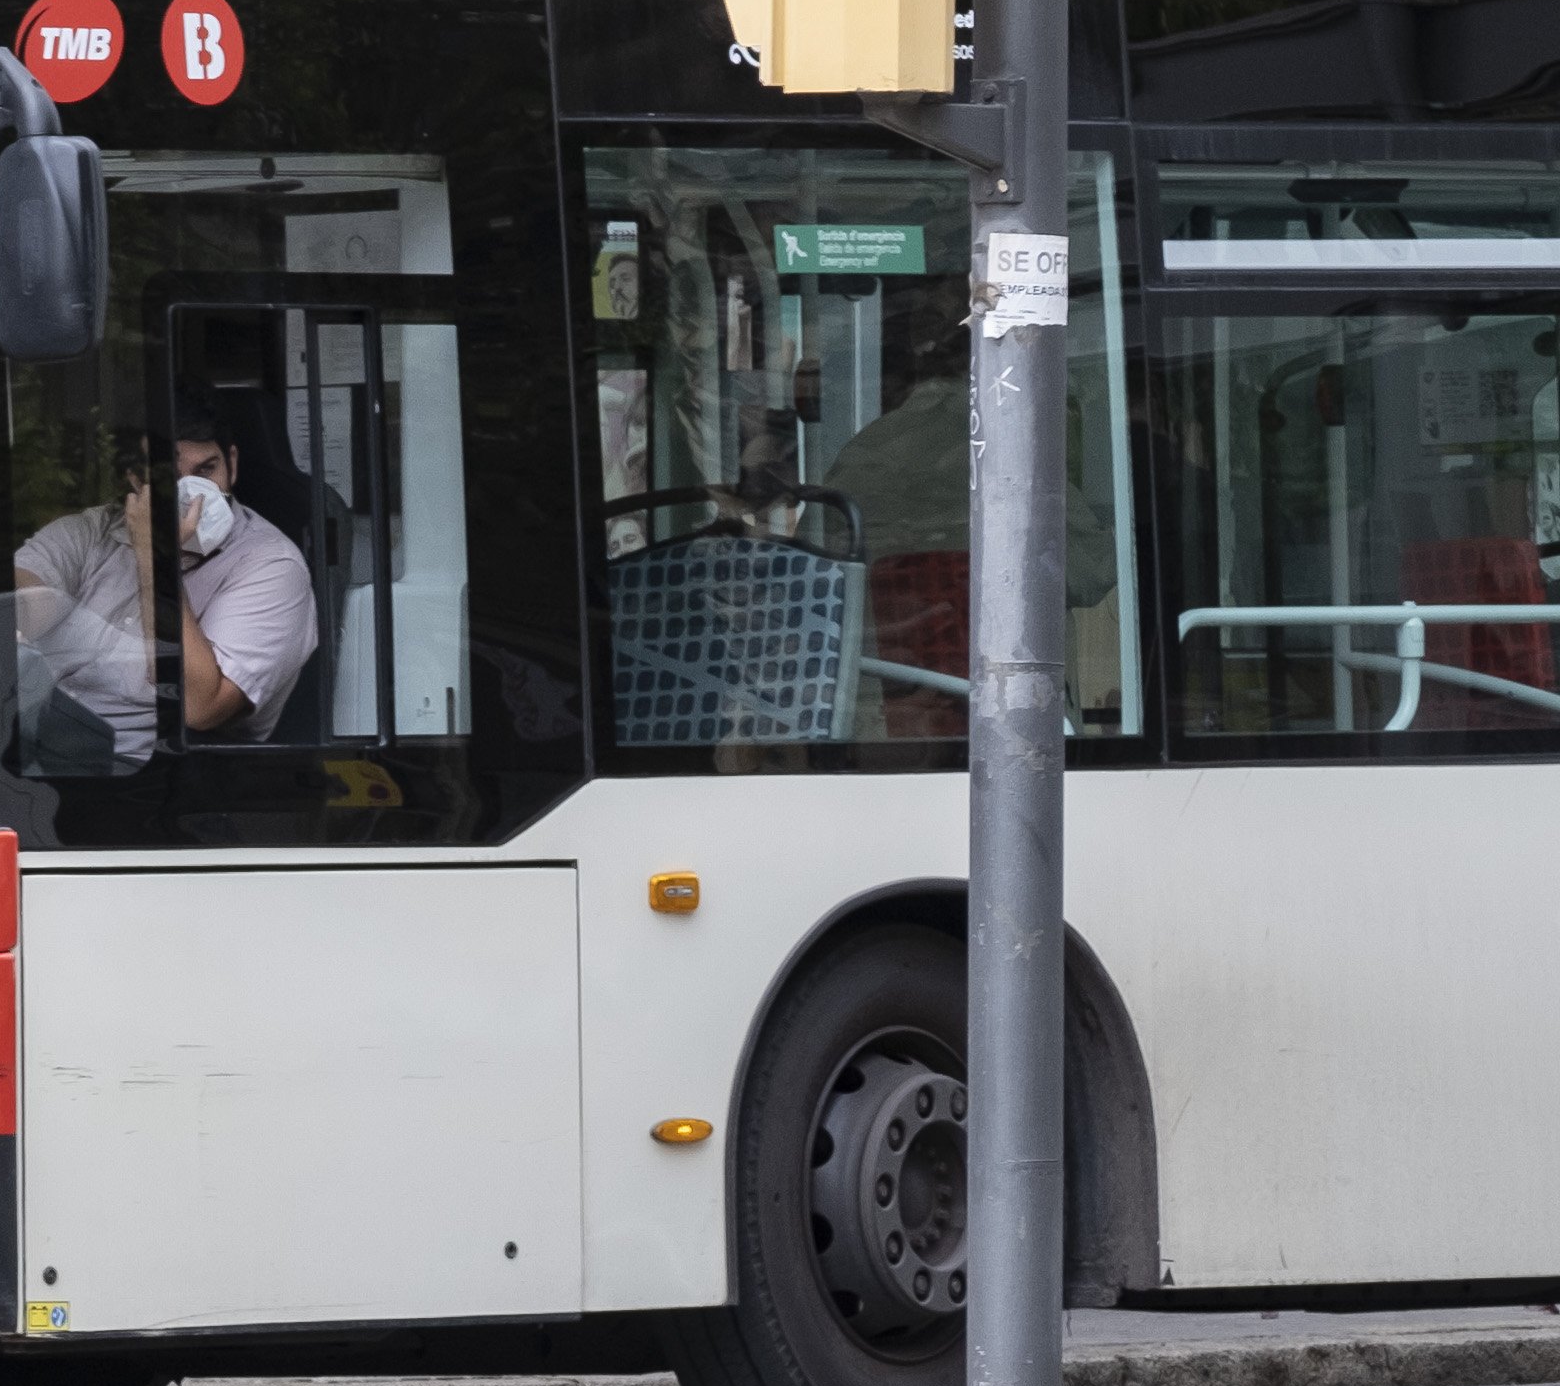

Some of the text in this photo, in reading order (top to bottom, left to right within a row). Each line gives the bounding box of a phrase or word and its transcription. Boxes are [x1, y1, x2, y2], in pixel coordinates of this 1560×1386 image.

[40, 26, 112, 61] TMB
[182, 12, 226, 80] B
[997, 249, 1030, 273] SE
